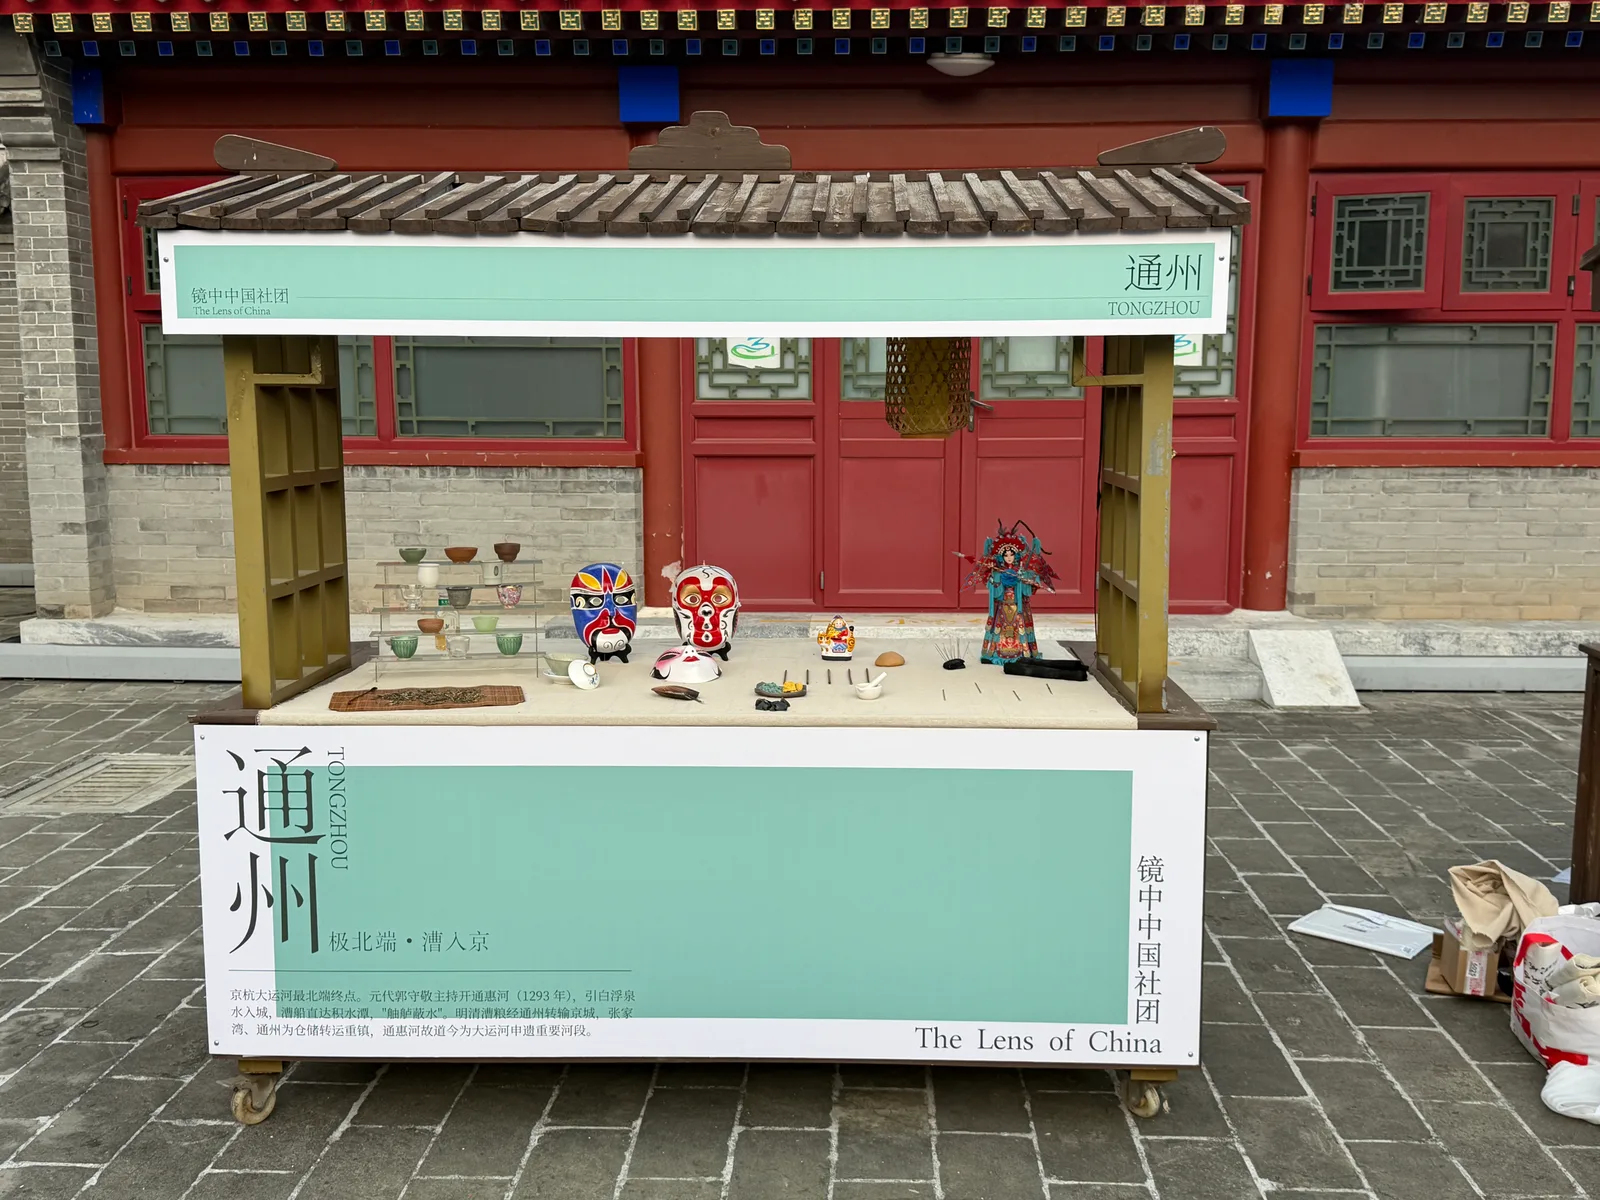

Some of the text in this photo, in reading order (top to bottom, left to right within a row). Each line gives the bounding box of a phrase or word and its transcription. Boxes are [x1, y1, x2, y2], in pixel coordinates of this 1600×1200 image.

[1124, 253, 1203, 292] 通州
[191, 287, 289, 304] 镜中中国社团
[193, 305, 271, 316] The Lens of China
[1108, 300, 1200, 316] TONGZHOU
[327, 747, 348, 870] TONGZHOU
[222, 746, 326, 954] 通州
[1134, 855, 1165, 1024] 镜中中国社团
[915, 1026, 1162, 1053] The Lens of China
